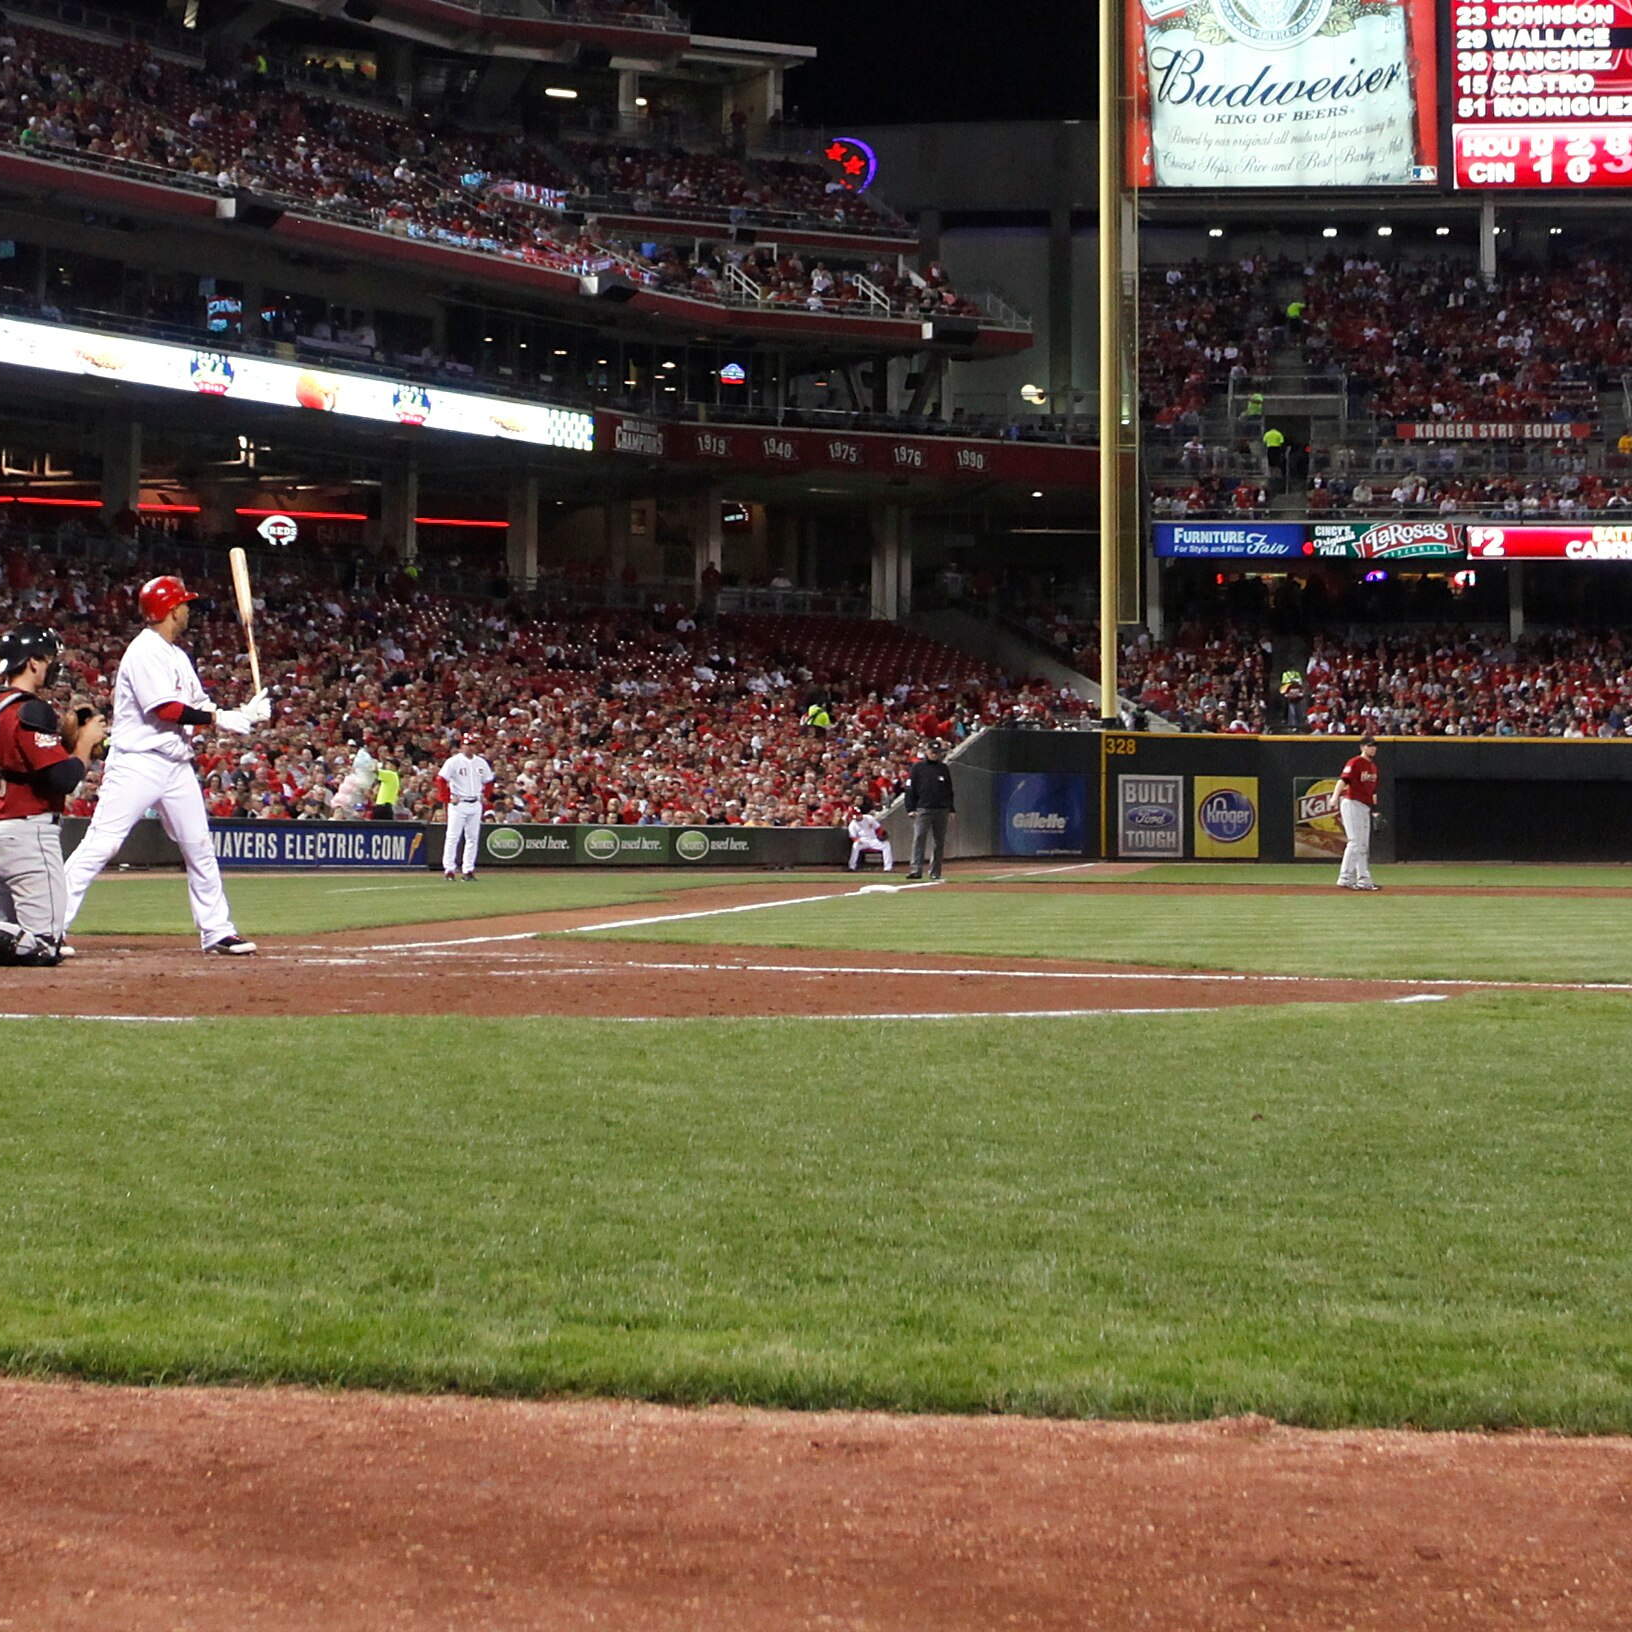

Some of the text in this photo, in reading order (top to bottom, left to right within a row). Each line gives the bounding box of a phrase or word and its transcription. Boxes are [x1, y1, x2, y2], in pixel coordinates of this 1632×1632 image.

[1492, 5, 1613, 25] JOHNSON
[1492, 28, 1610, 48] WALLACE
[1493, 50, 1611, 70] SANCHEZ
[1149, 46, 1403, 108] Budweiser
[1493, 73, 1594, 93] CASTRO
[1214, 106, 1349, 125] KING OF BEERS
[1462, 136, 1521, 157] HOU
[1468, 161, 1515, 182] CIN
[615, 425, 665, 455] CHAMPIONS
[1415, 423, 1572, 438] KROGER STRIEOUTS
[698, 434, 727, 457] 1919
[762, 437, 793, 460] 1940
[828, 440, 858, 463] 1975
[893, 444, 923, 467] 1976
[956, 448, 985, 471] 1990
[1174, 527, 1245, 544] FURNITURE
[1245, 532, 1290, 555] Fair
[1320, 544, 1348, 556] PIZZA
[1105, 738, 1137, 755] 328
[1124, 782, 1176, 803] BUILT
[1012, 812, 1067, 829] Gillette
[1135, 808, 1165, 824] Ford
[1206, 797, 1250, 835] Kroger
[208, 830, 406, 861] MAYERS ELECTRIC.COM
[525, 835, 570, 850] used here.
[621, 837, 663, 851] used here.
[710, 838, 750, 852] used here.
[1125, 830, 1177, 848] TOUGH
